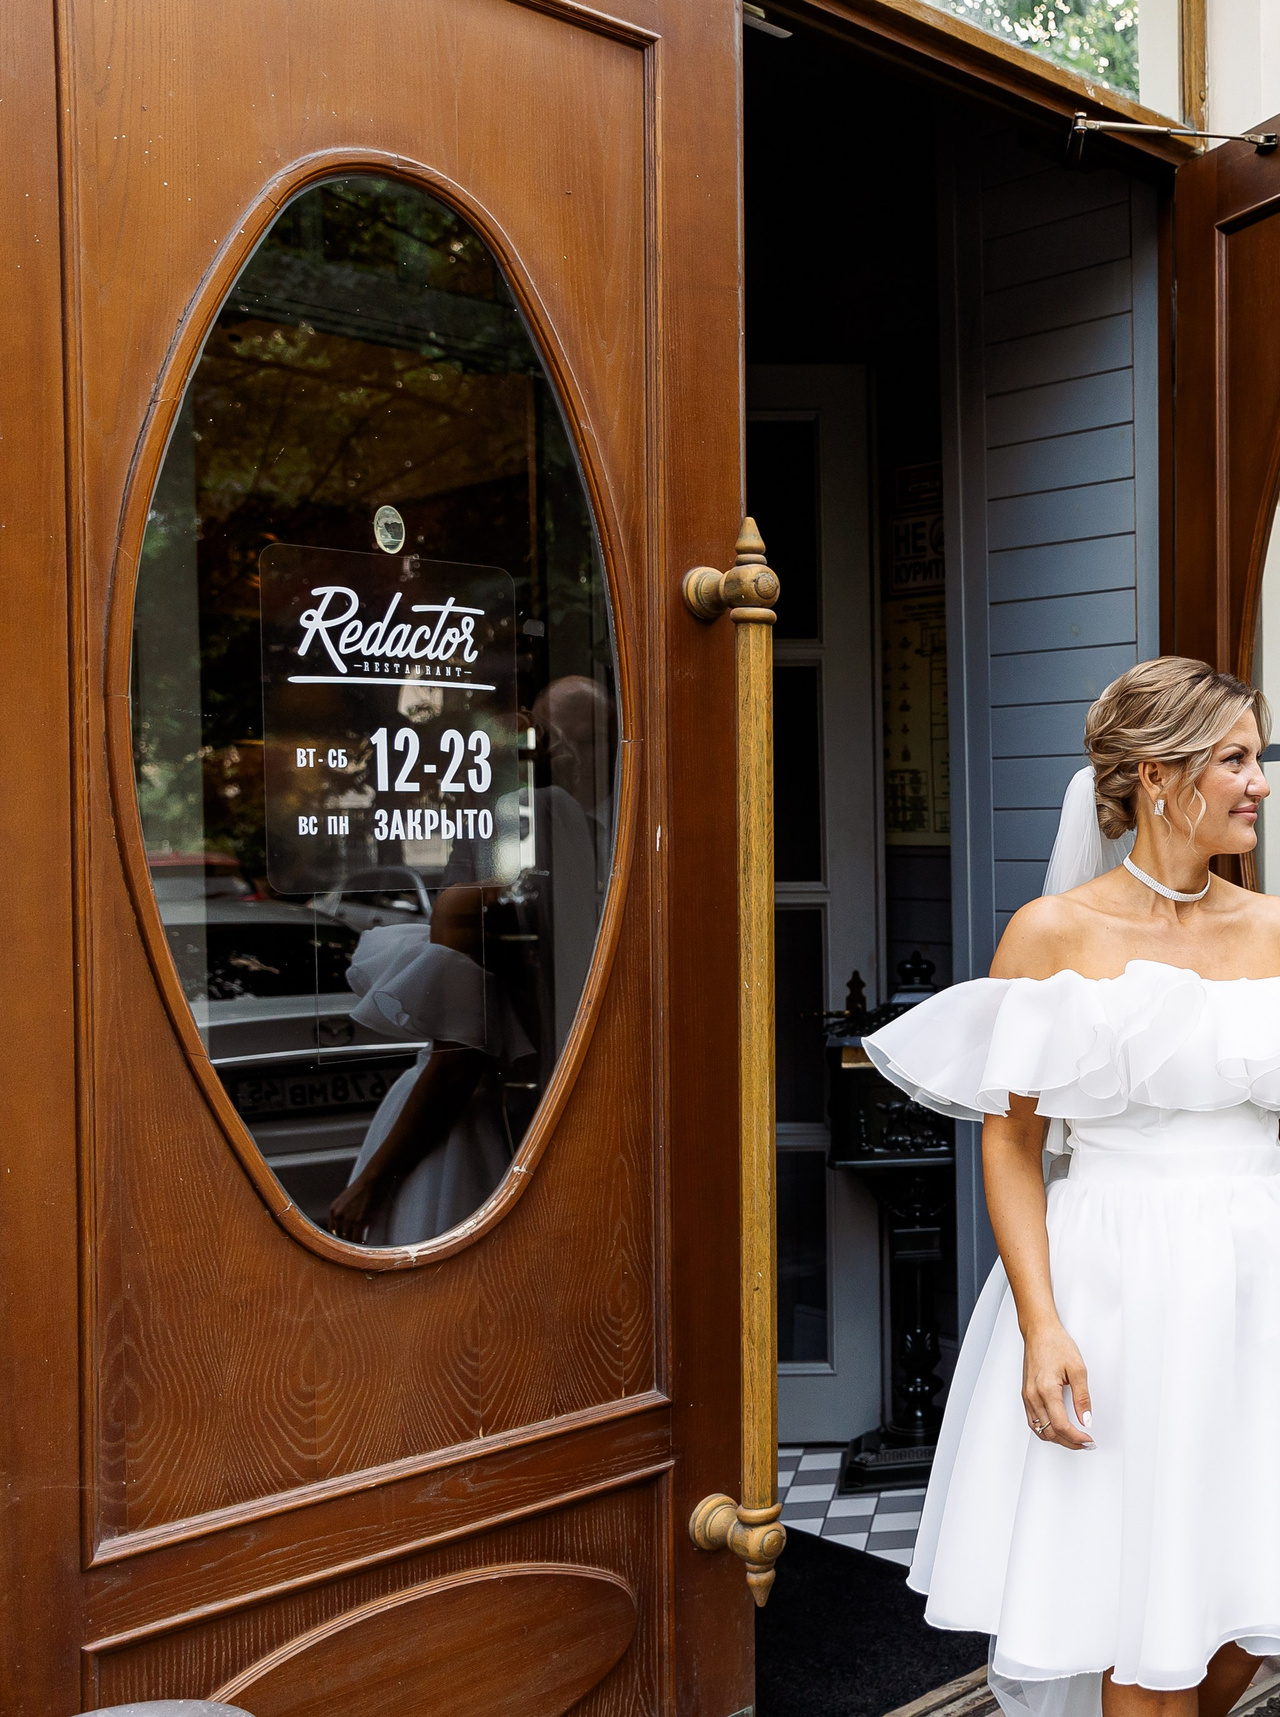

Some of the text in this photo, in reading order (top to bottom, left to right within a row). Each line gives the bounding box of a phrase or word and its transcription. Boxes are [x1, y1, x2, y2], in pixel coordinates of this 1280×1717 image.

[894, 521, 927, 555] НЕ
[297, 586, 485, 674] Redactor
[369, 727, 492, 793] 12-23
[298, 808, 494, 841] ВС ПН ЗАКРЫТО
